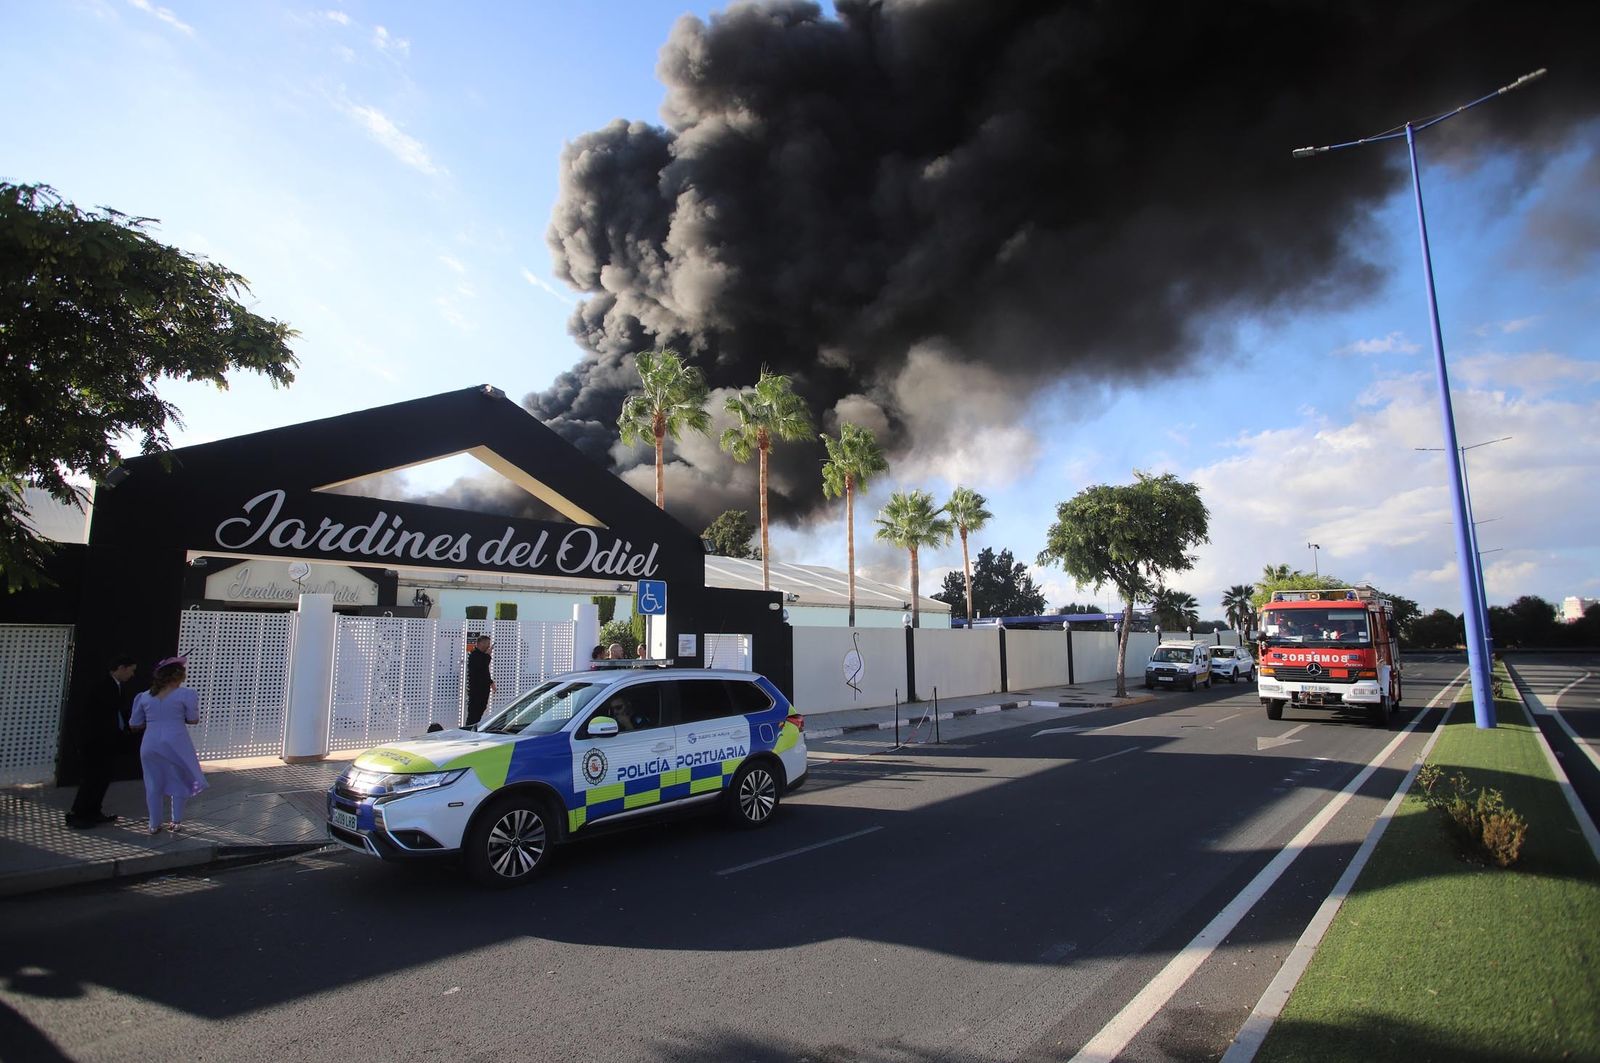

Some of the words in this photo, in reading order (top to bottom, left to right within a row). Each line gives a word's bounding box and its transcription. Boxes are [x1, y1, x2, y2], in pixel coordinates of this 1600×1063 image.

[215, 489, 472, 562] Jardines
[477, 526, 549, 568] del
[556, 527, 659, 577] Odiel
[227, 567, 295, 600] Jardines
[617, 757, 670, 781] POLICÍA
[677, 745, 747, 768] PORTUARIA
